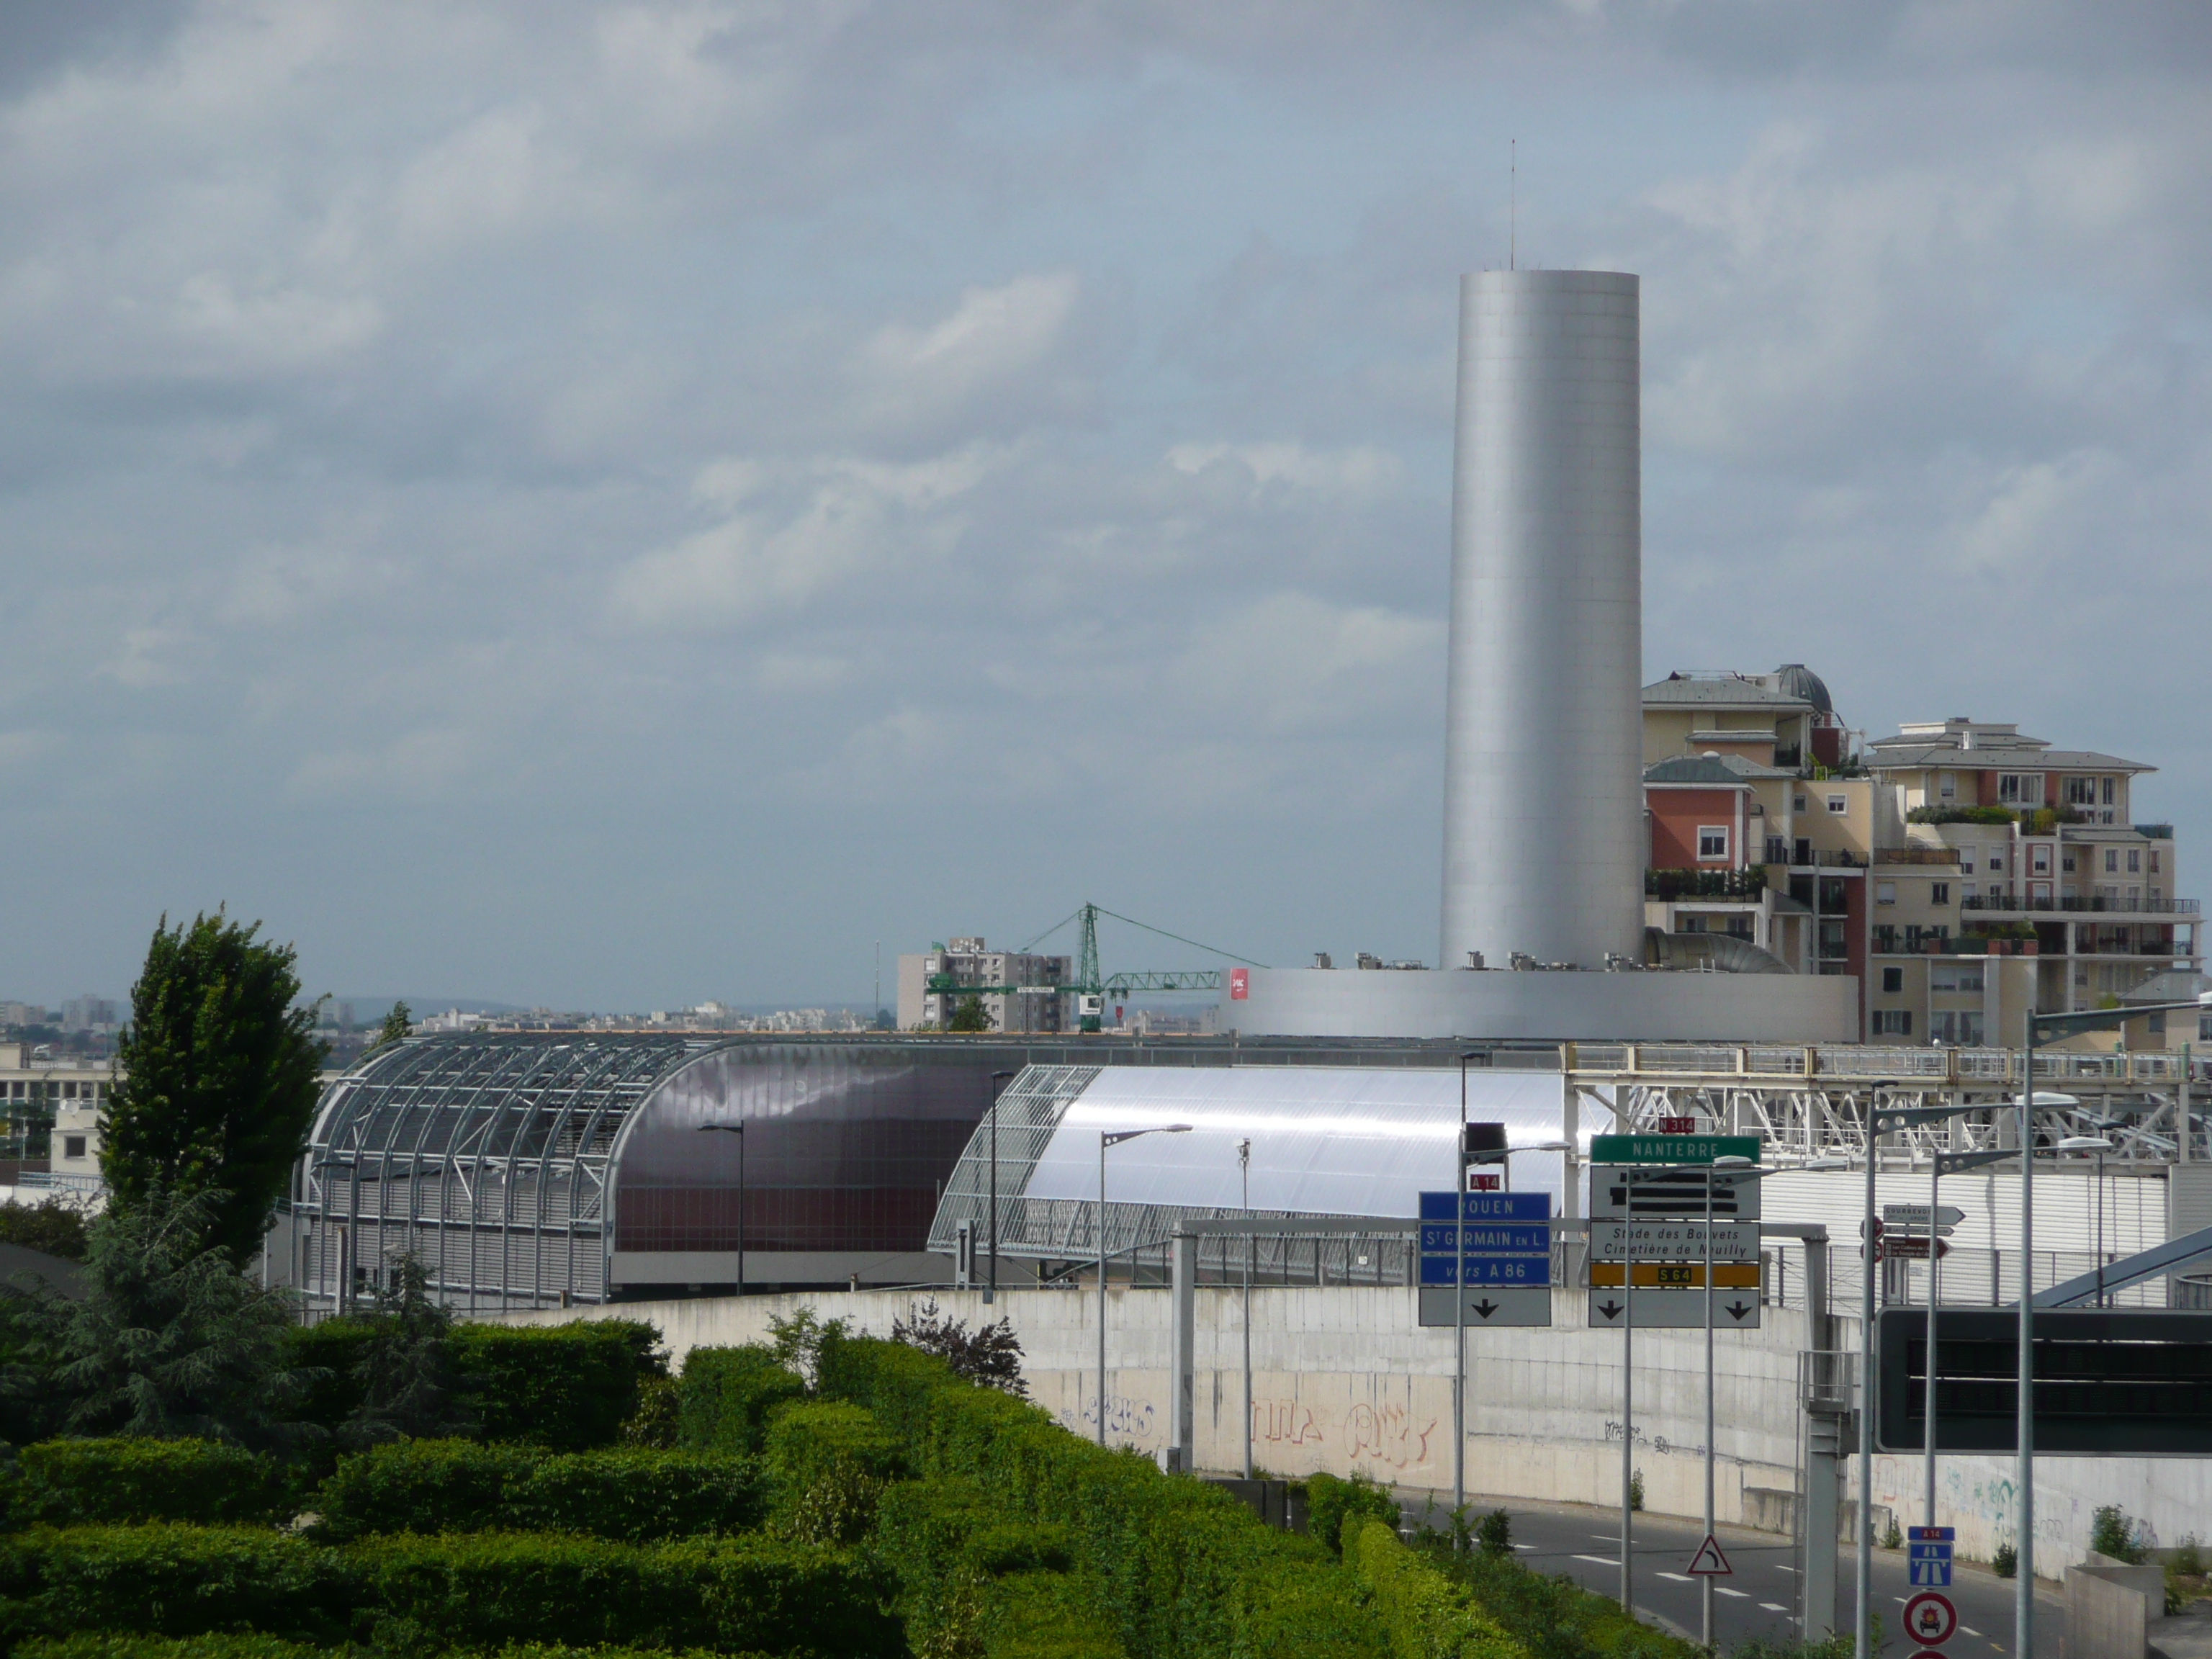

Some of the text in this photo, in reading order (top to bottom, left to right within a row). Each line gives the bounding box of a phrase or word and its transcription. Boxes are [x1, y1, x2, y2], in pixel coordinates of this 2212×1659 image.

[1660, 1120, 1693, 1130] N 314
[1632, 1142, 1719, 1157] NANTERRE
[1473, 1177, 1498, 1187] A 14
[1886, 1207, 1932, 1215] COURBEVOI
[1613, 1227, 1650, 1239] Stade
[1658, 1228, 1679, 1239] des
[1516, 1236, 1527, 1246] EN
[1676, 1244, 1691, 1254] de
[1490, 1264, 1498, 1278] A
[1505, 1264, 1526, 1278] 86
[1660, 1269, 1690, 1280] S 64
[1923, 1529, 1941, 1538] A 14
